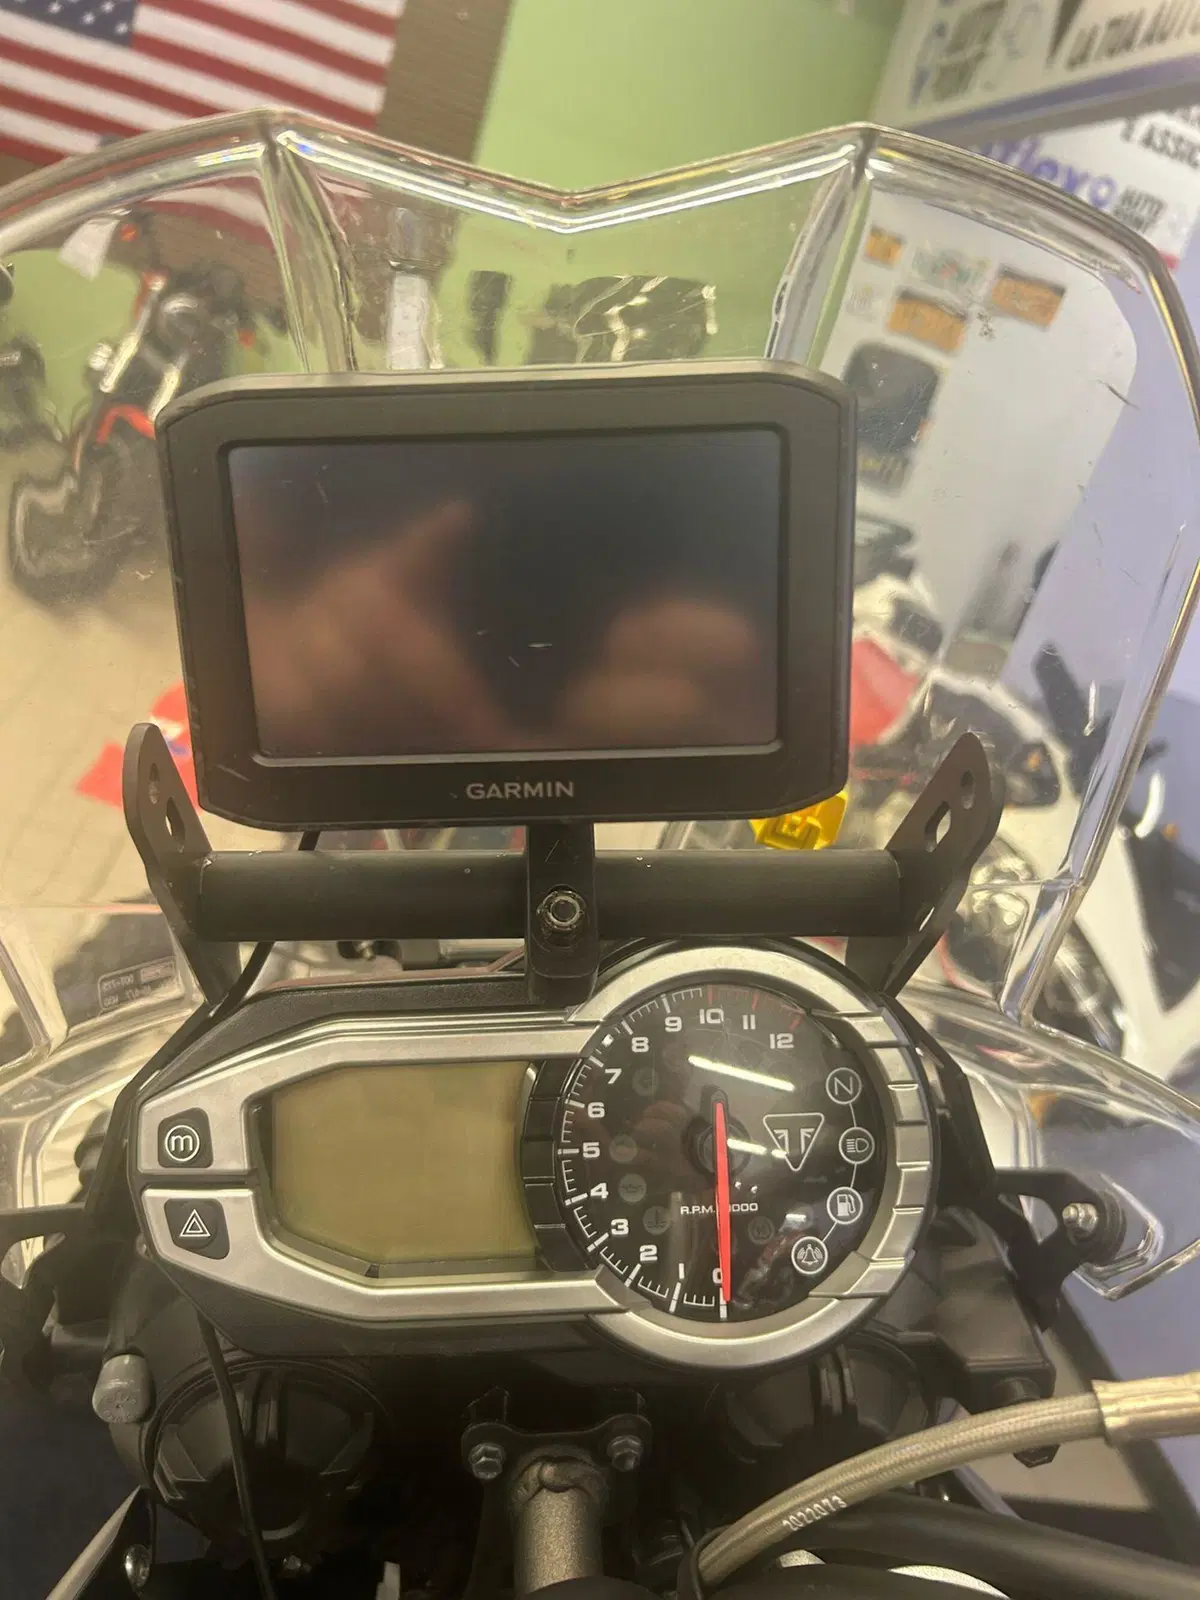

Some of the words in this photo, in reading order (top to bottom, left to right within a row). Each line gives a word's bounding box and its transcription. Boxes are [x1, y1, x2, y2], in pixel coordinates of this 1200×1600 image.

[466, 781, 574, 800] GARMIN
[664, 1016, 683, 1033] 9
[699, 1008, 725, 1024] 10
[742, 1014, 756, 1030] 11
[631, 1036, 650, 1053] 8
[769, 1033, 795, 1050] 12
[604, 1067, 623, 1085] 7
[834, 1076, 853, 1096] N
[587, 1102, 606, 1119] 6
[171, 1135, 193, 1152] m
[582, 1142, 601, 1158] 5
[590, 1182, 609, 1200] 4
[680, 1205, 716, 1215] R.P.M.
[610, 1218, 629, 1236] 3
[639, 1244, 658, 1262] 2
[678, 1263, 685, 1280] 1
[782, 1494, 848, 1532] 2022073
